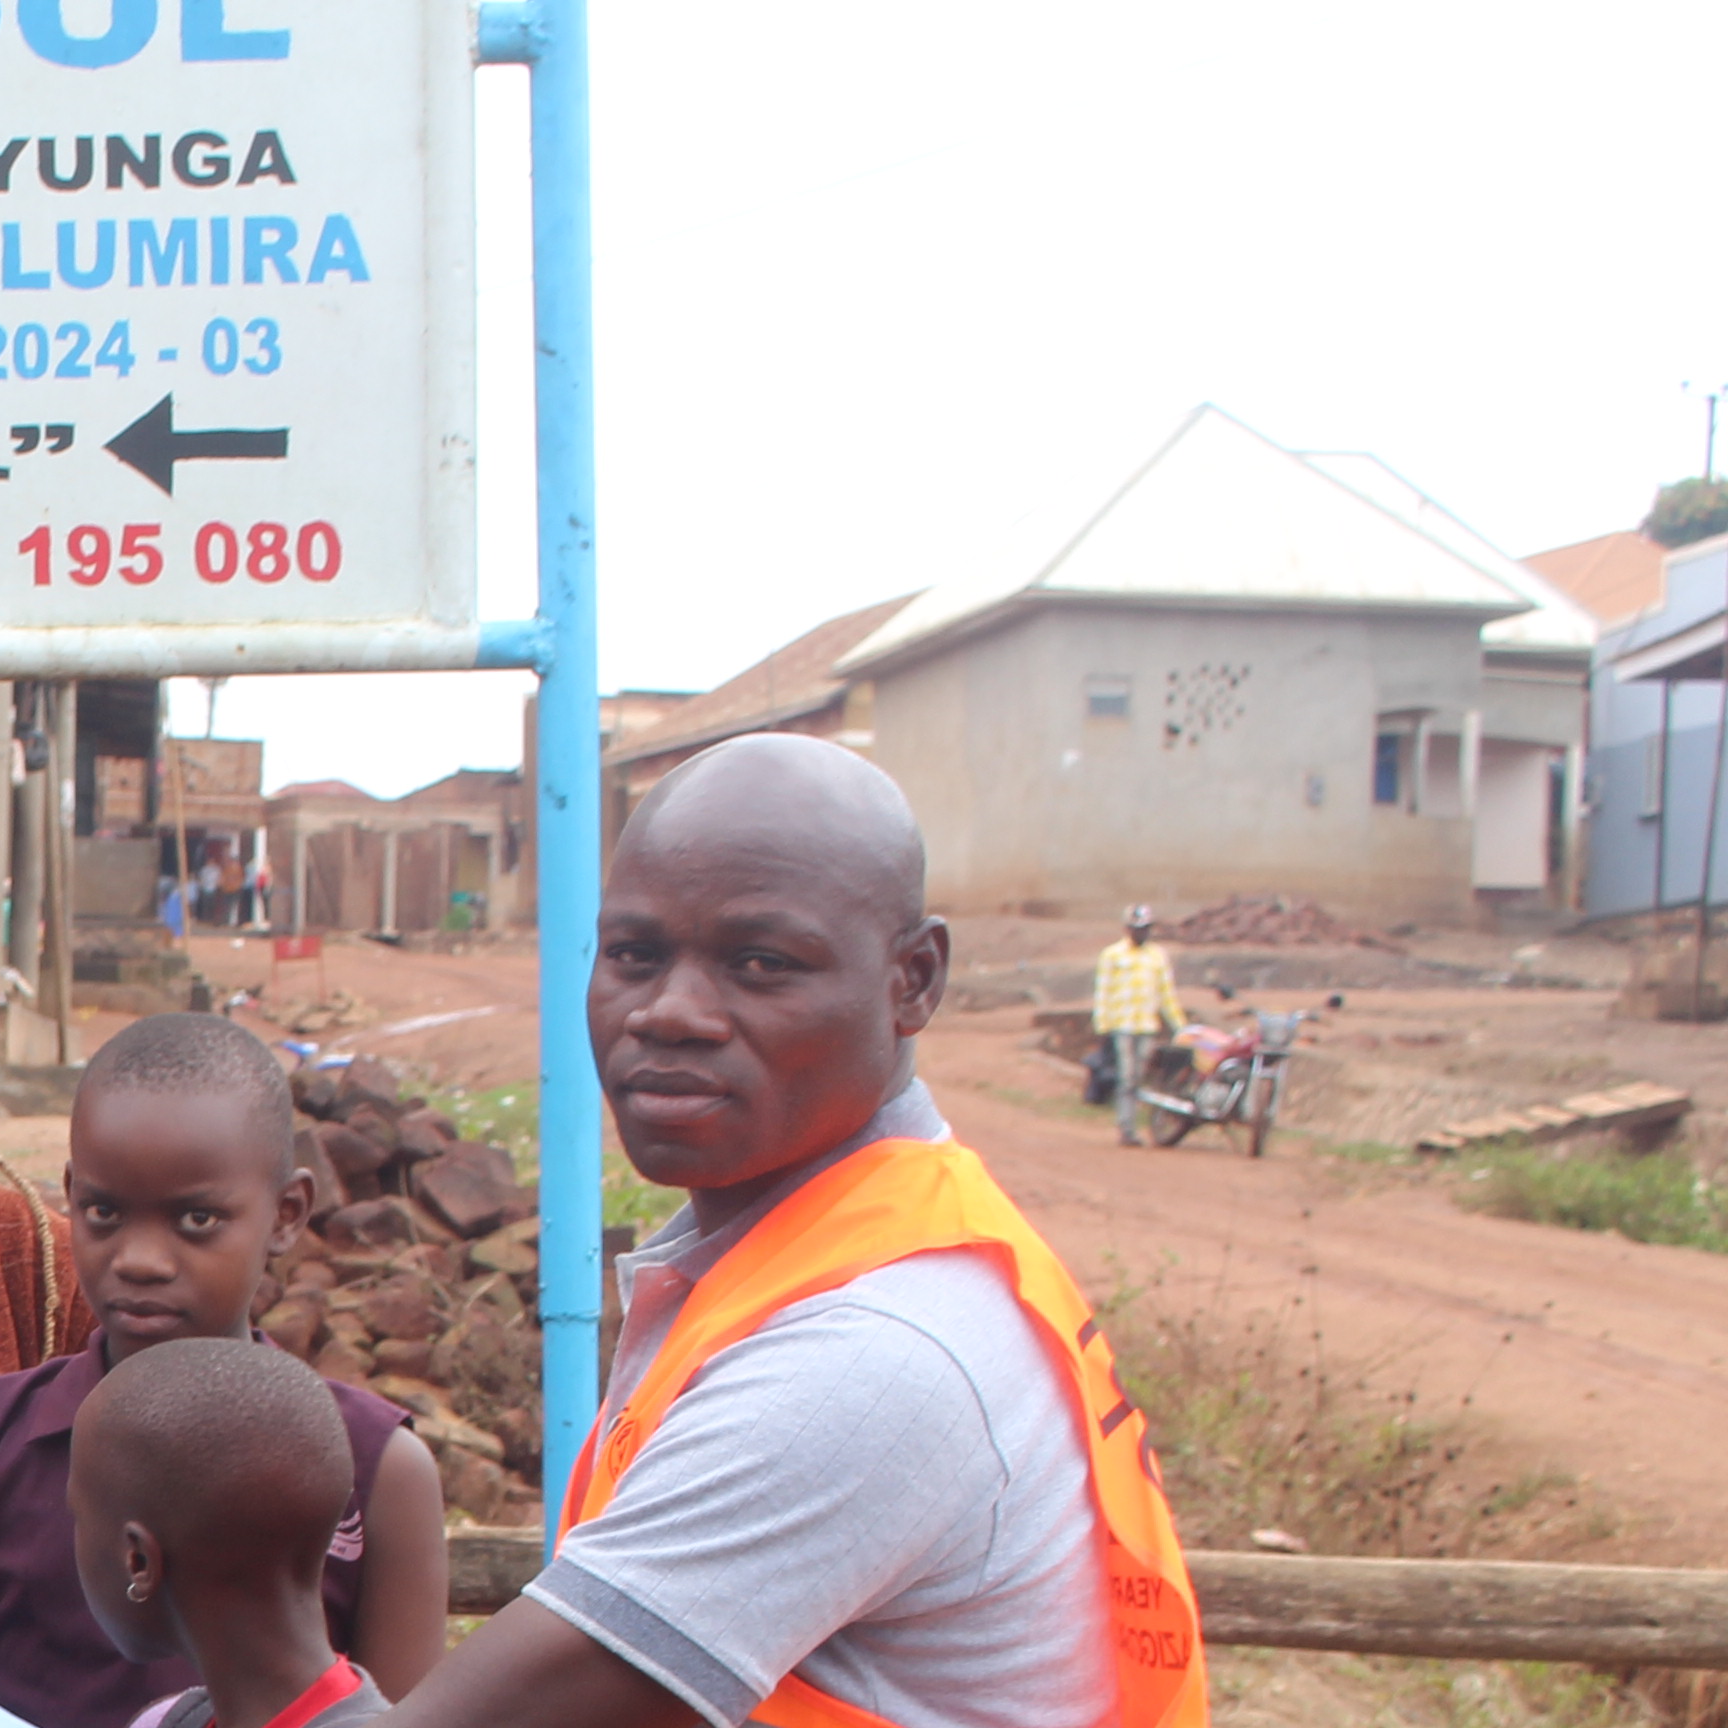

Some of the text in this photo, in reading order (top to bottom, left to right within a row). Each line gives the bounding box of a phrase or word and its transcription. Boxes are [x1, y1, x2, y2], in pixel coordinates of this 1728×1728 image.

[202, 316, 283, 376] 03
[19, 524, 164, 587] 195
[194, 521, 342, 584] 080
